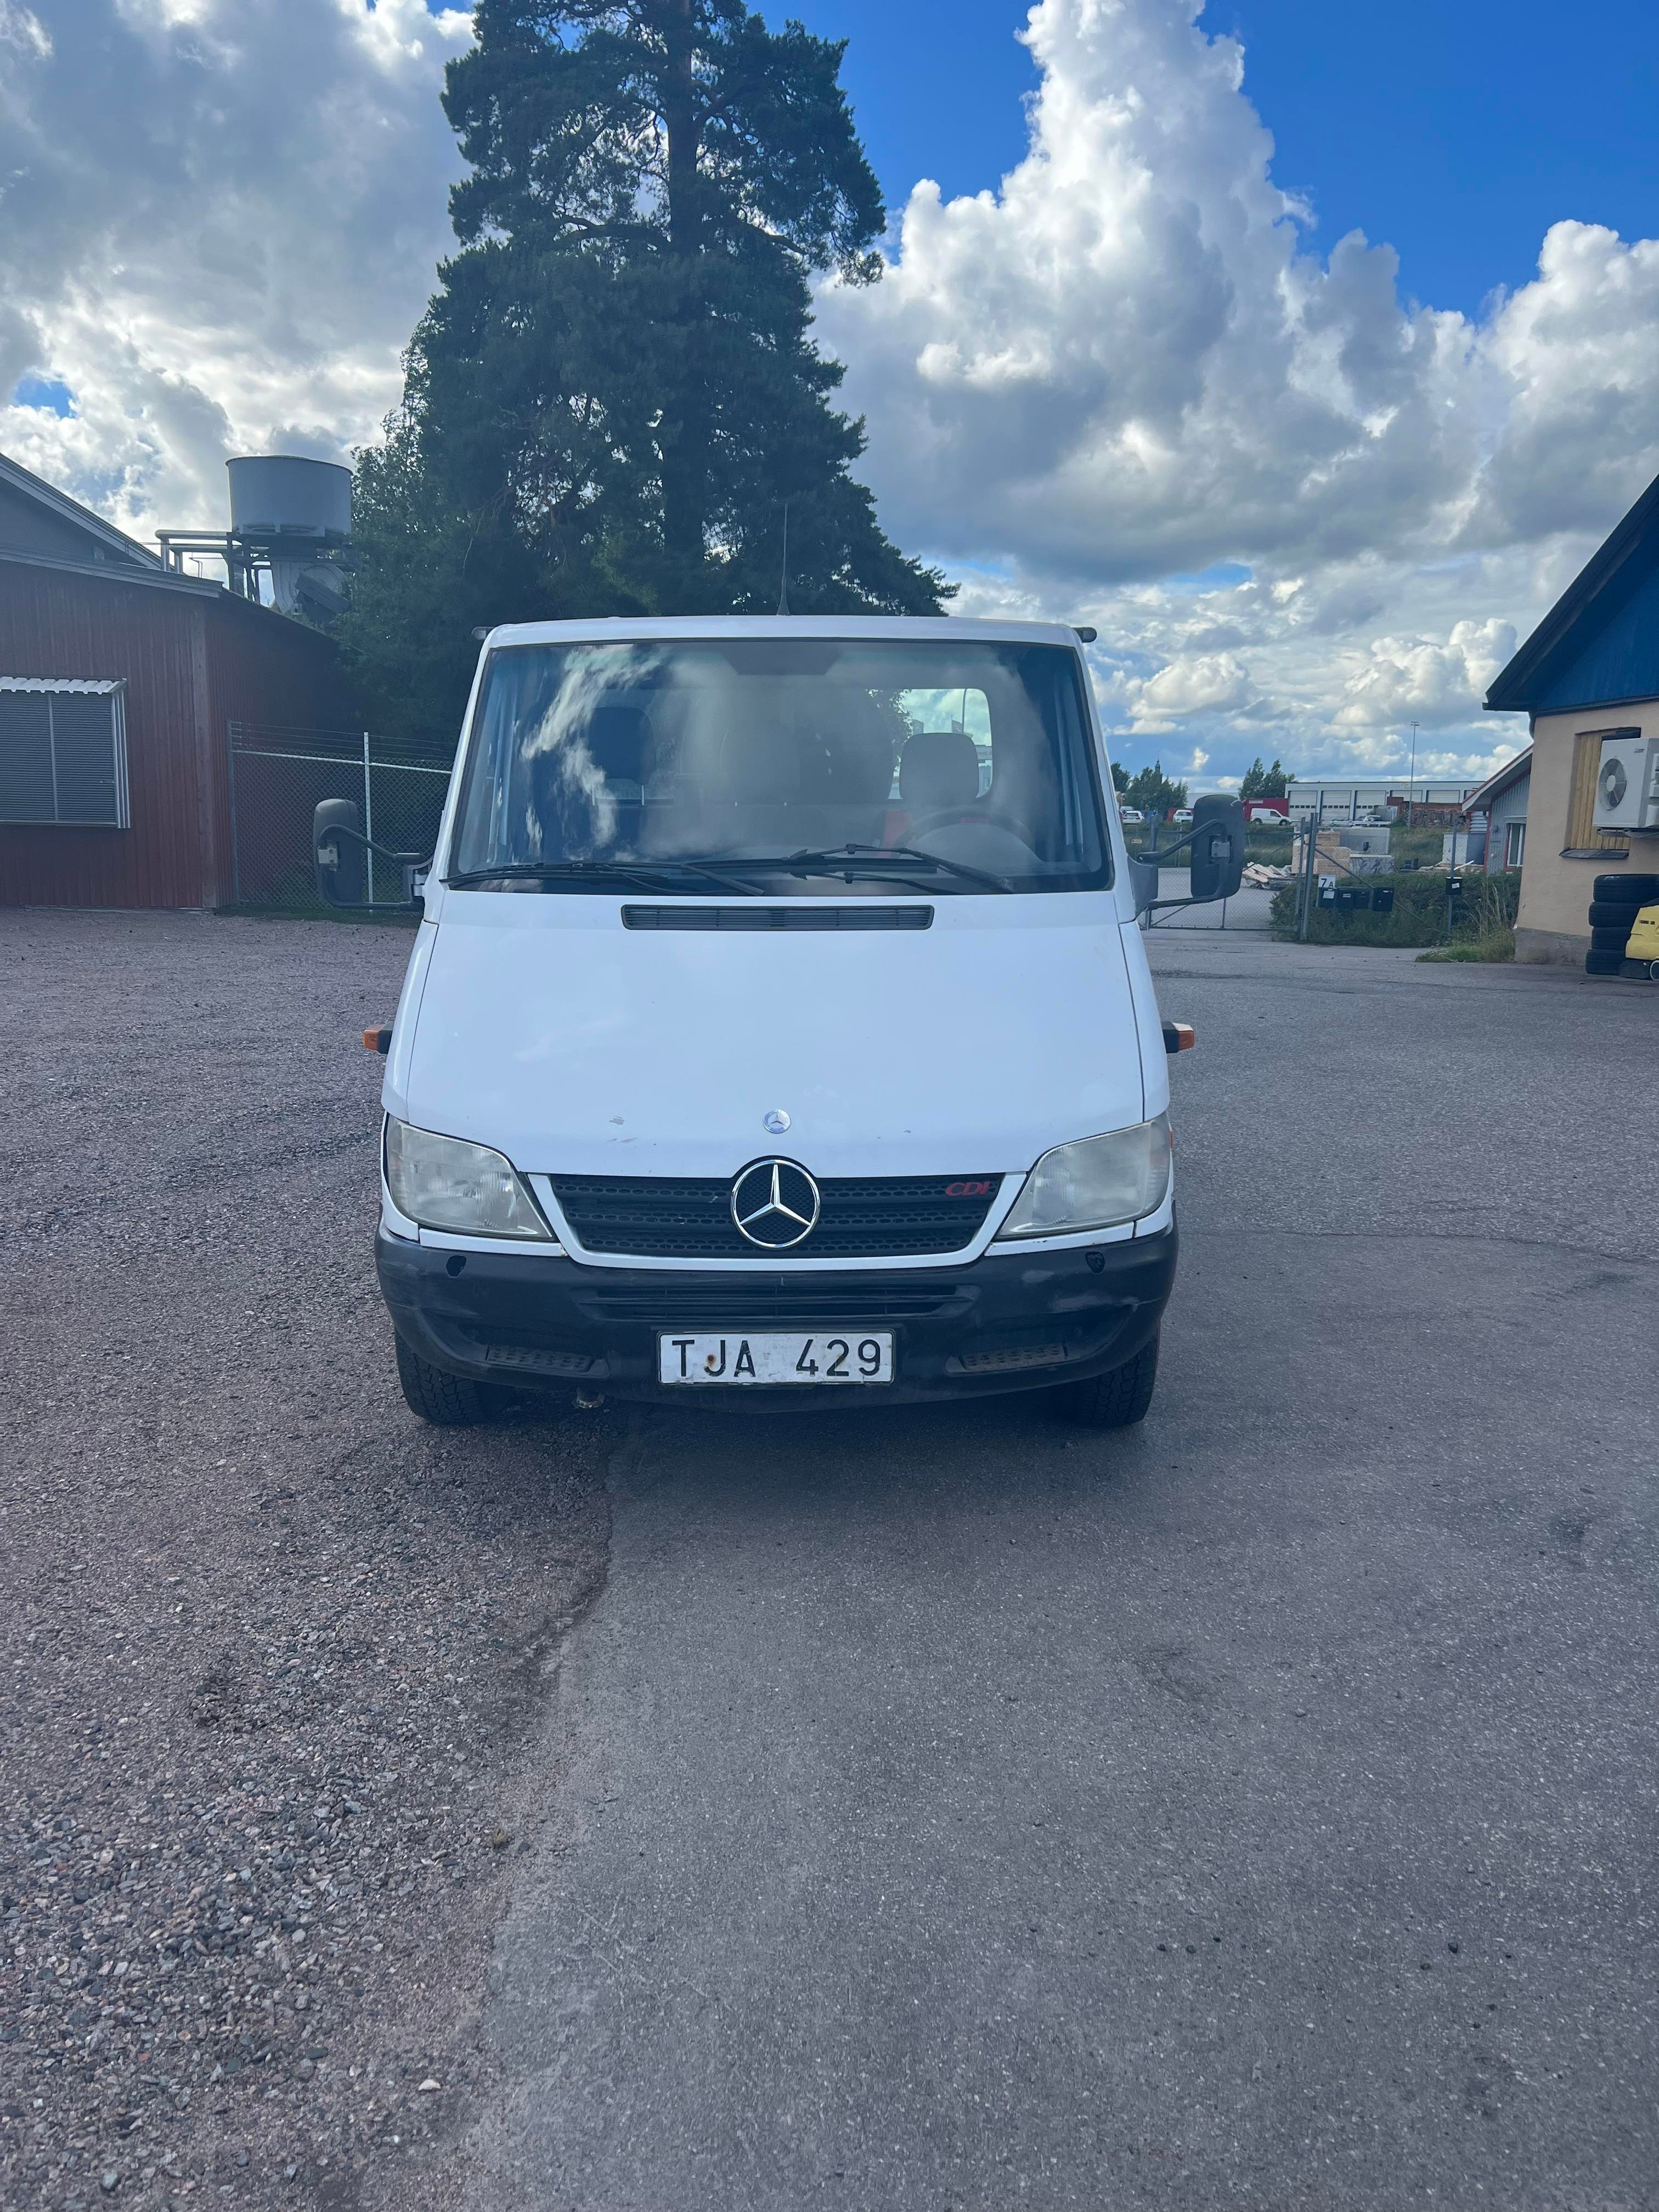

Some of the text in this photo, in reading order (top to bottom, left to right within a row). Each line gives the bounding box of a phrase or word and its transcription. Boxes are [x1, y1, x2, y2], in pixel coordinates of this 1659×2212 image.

[945, 1181, 991, 1196] CDI
[672, 1339, 881, 1377] TJA 429
